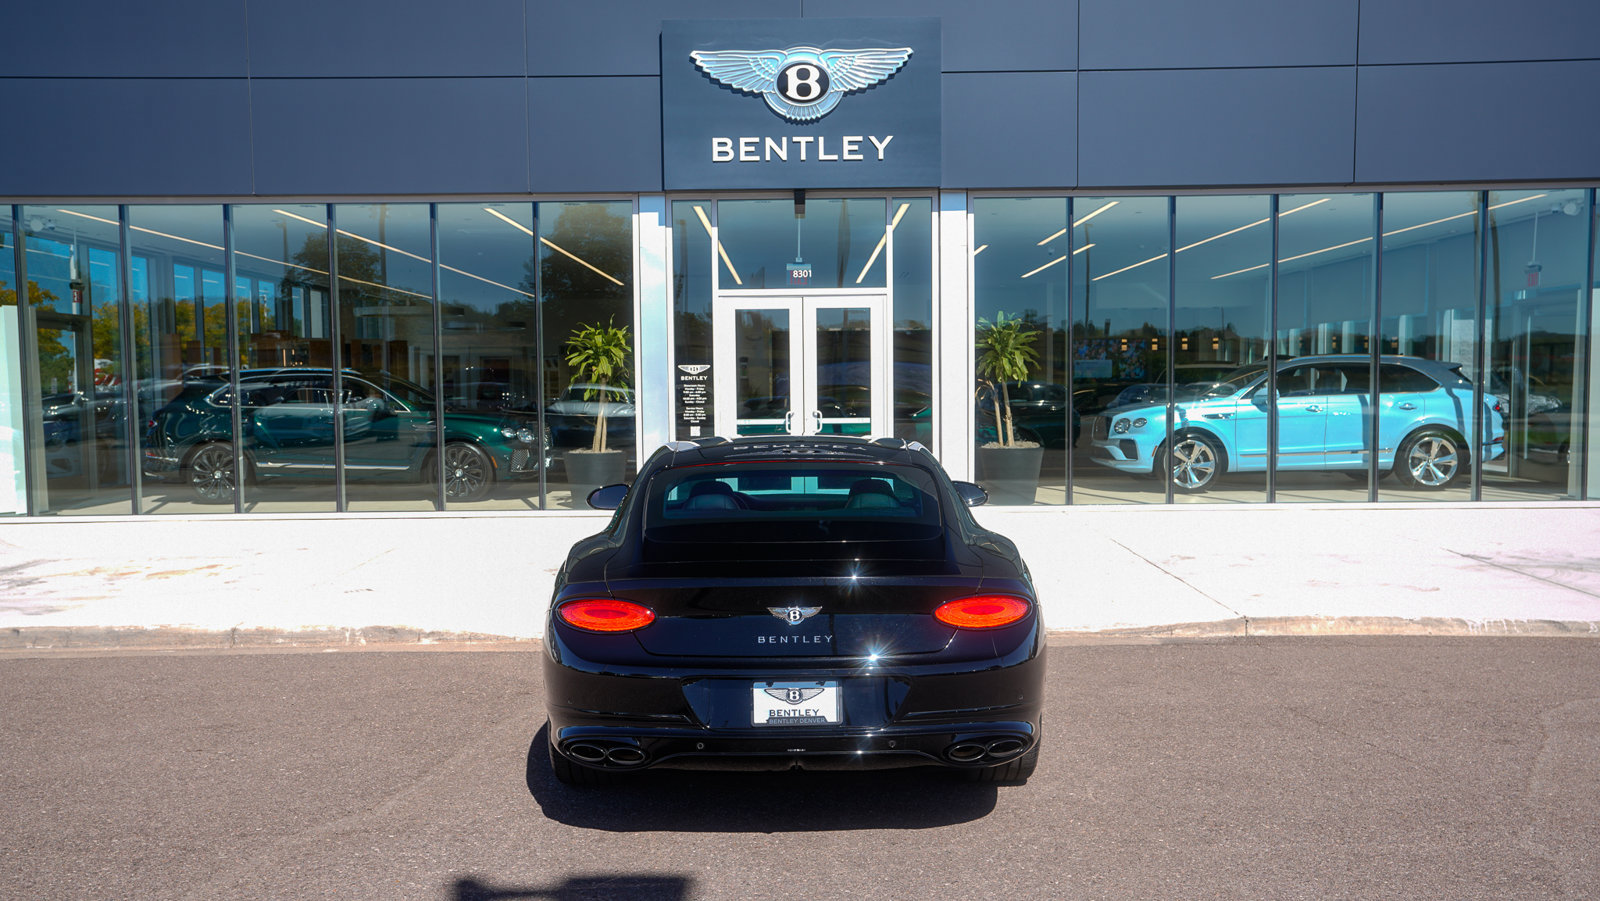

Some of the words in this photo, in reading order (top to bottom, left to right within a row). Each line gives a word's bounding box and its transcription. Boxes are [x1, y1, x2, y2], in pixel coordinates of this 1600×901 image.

[785, 64, 821, 100] B
[711, 135, 894, 162] BENTLEY
[792, 269, 812, 278] 8301
[789, 611, 800, 622] B
[757, 635, 833, 644] BENTLEY
[789, 690, 800, 701] B
[769, 708, 820, 717] BENTLEY
